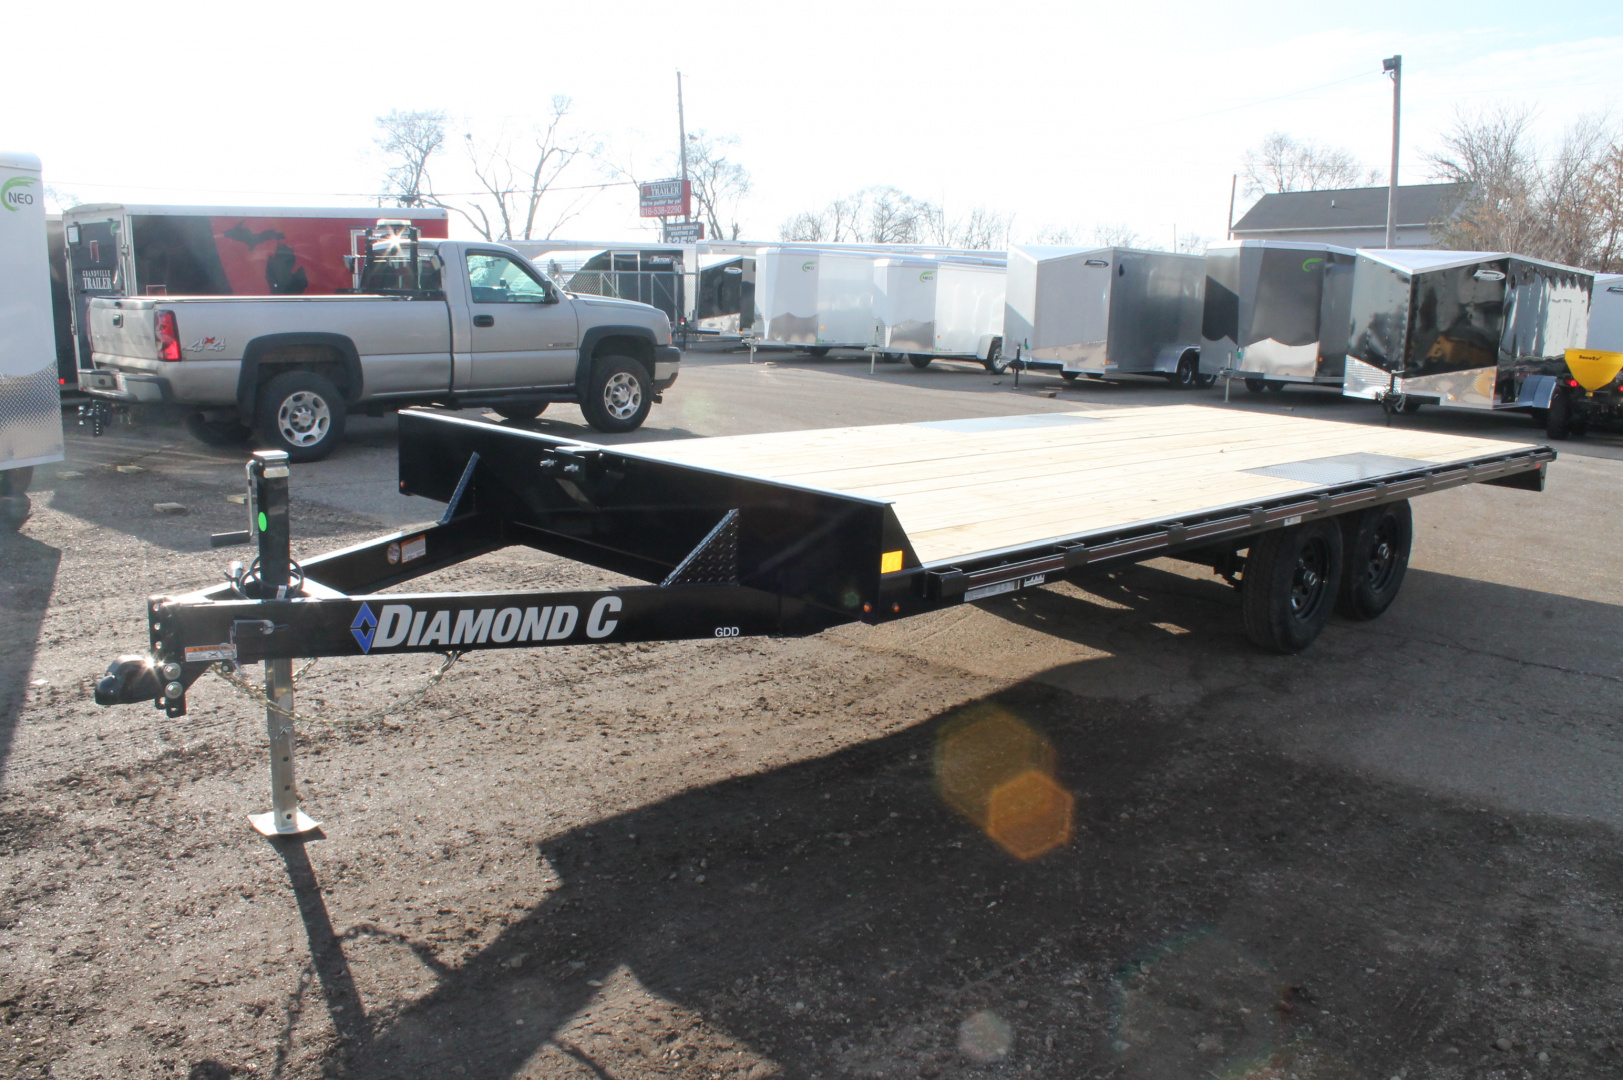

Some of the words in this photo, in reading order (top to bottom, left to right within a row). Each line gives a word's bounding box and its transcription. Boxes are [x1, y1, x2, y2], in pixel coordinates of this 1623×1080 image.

[651, 187, 679, 196] TRAILER
[8, 191, 33, 205] NEO
[641, 205, 682, 216] 616-538-2290
[82, 277, 112, 290] TRAILER
[371, 604, 579, 648] DIAMOND
[586, 595, 623, 639] C
[714, 626, 740, 637] GDD
